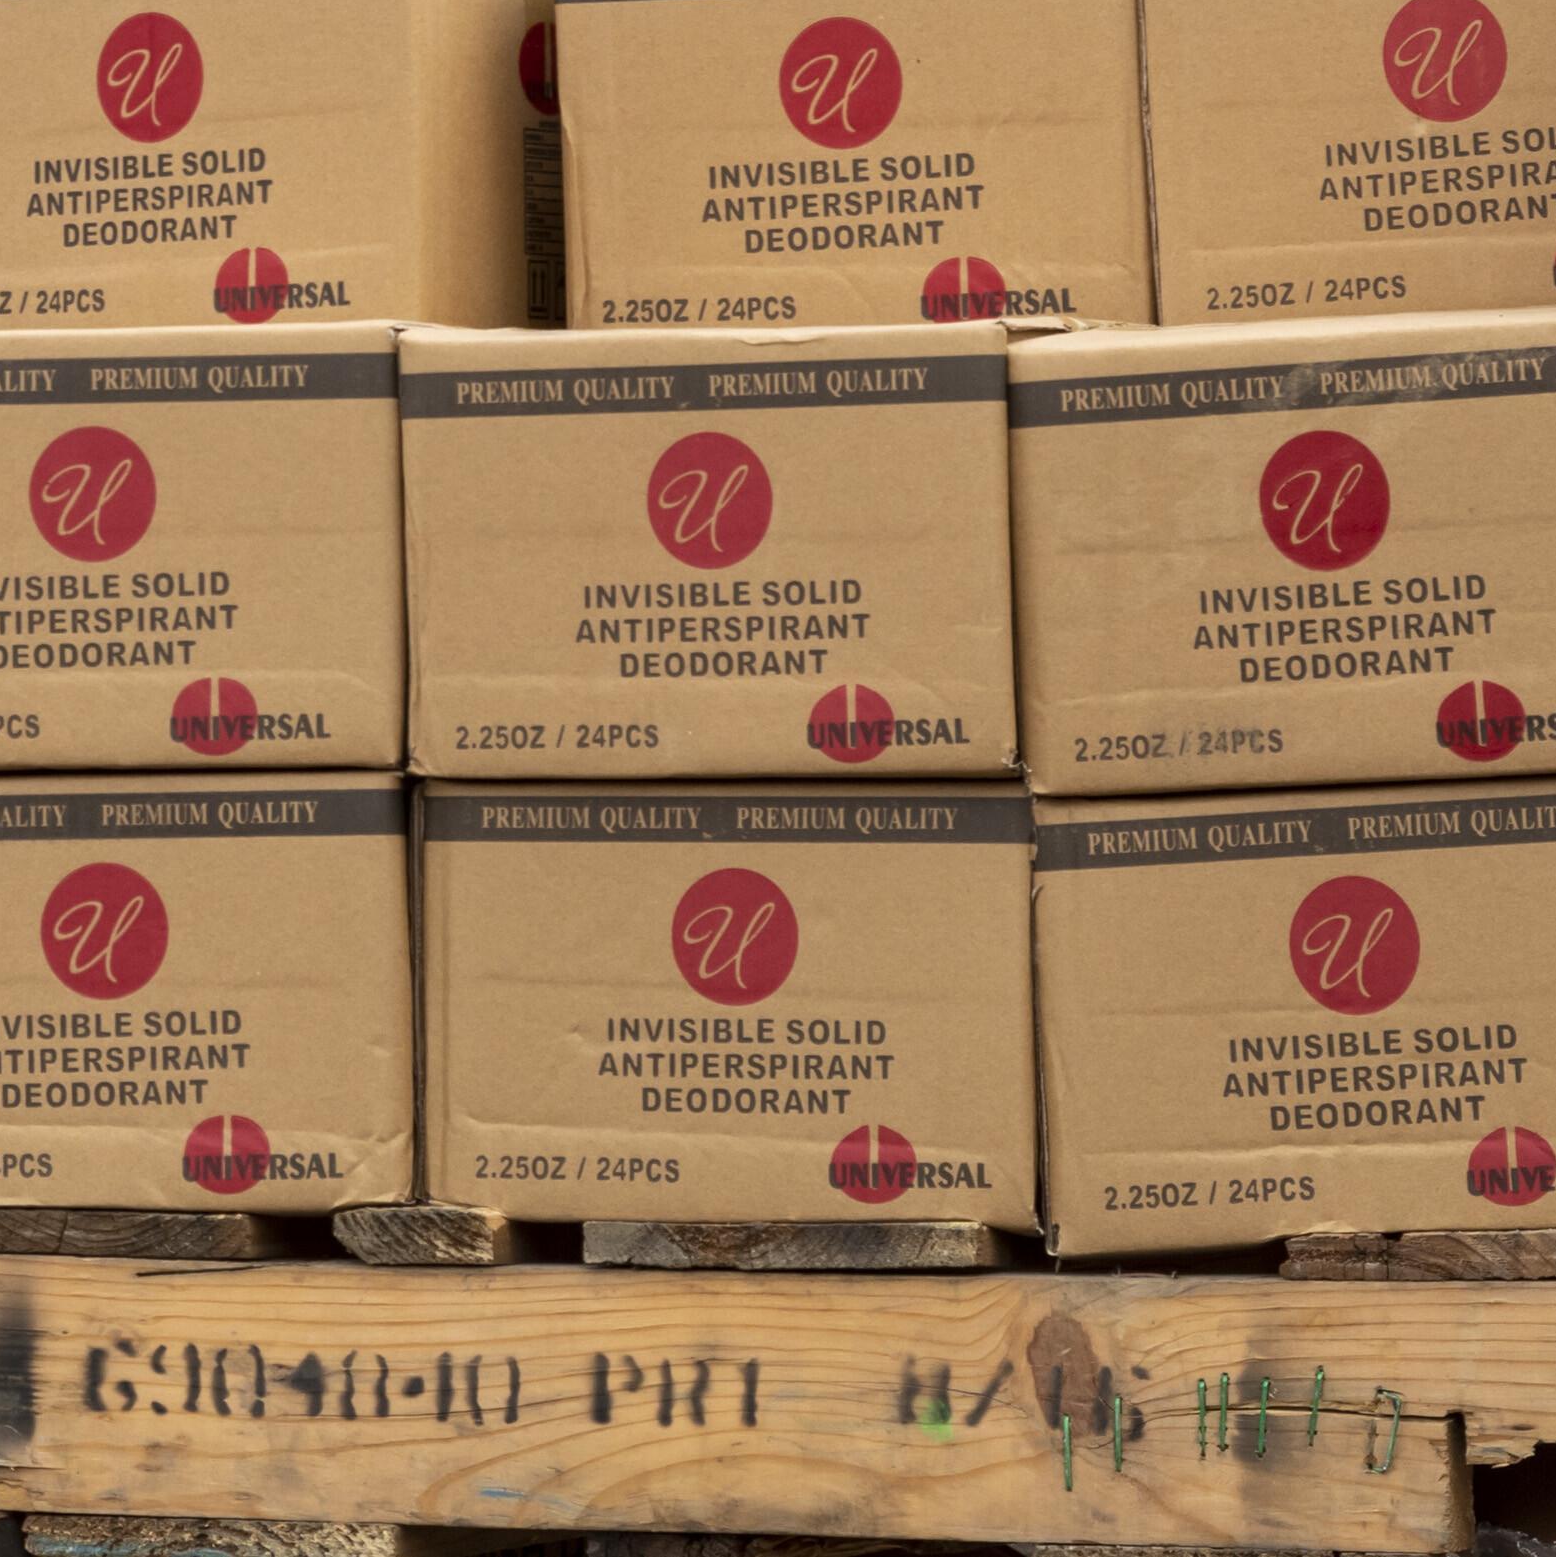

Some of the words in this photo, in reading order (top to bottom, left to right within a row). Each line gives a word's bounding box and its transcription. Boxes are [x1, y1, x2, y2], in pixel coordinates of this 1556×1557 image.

[1326, 132, 1490, 166] INVISIBLE
[603, 299, 689, 323] 2.25OZ
[698, 299, 707, 321] /
[717, 296, 796, 321] 24PCS
[920, 288, 1077, 320] UNIVERSAL
[709, 371, 816, 398] PREMIUM
[827, 367, 928, 394] QUALITY
[585, 582, 750, 608] INVISIBLE
[763, 580, 861, 606] SOLID
[576, 614, 870, 643] ANTIPERSPIRANT
[620, 649, 828, 677] DEODORANT
[1075, 734, 1167, 763] 2.25OZ
[1197, 729, 1284, 757] 24PCS
[482, 806, 590, 829] PREMIUM
[601, 806, 702, 831] QUALITY
[1230, 1030, 1402, 1062] INVISIBLE
[1414, 1025, 1516, 1053] SOLID
[1223, 1058, 1527, 1097] ANTIPERSPIRANT
[1270, 1095, 1485, 1130] DEODORANT
[182, 1153, 343, 1183] UNIVERSAL
